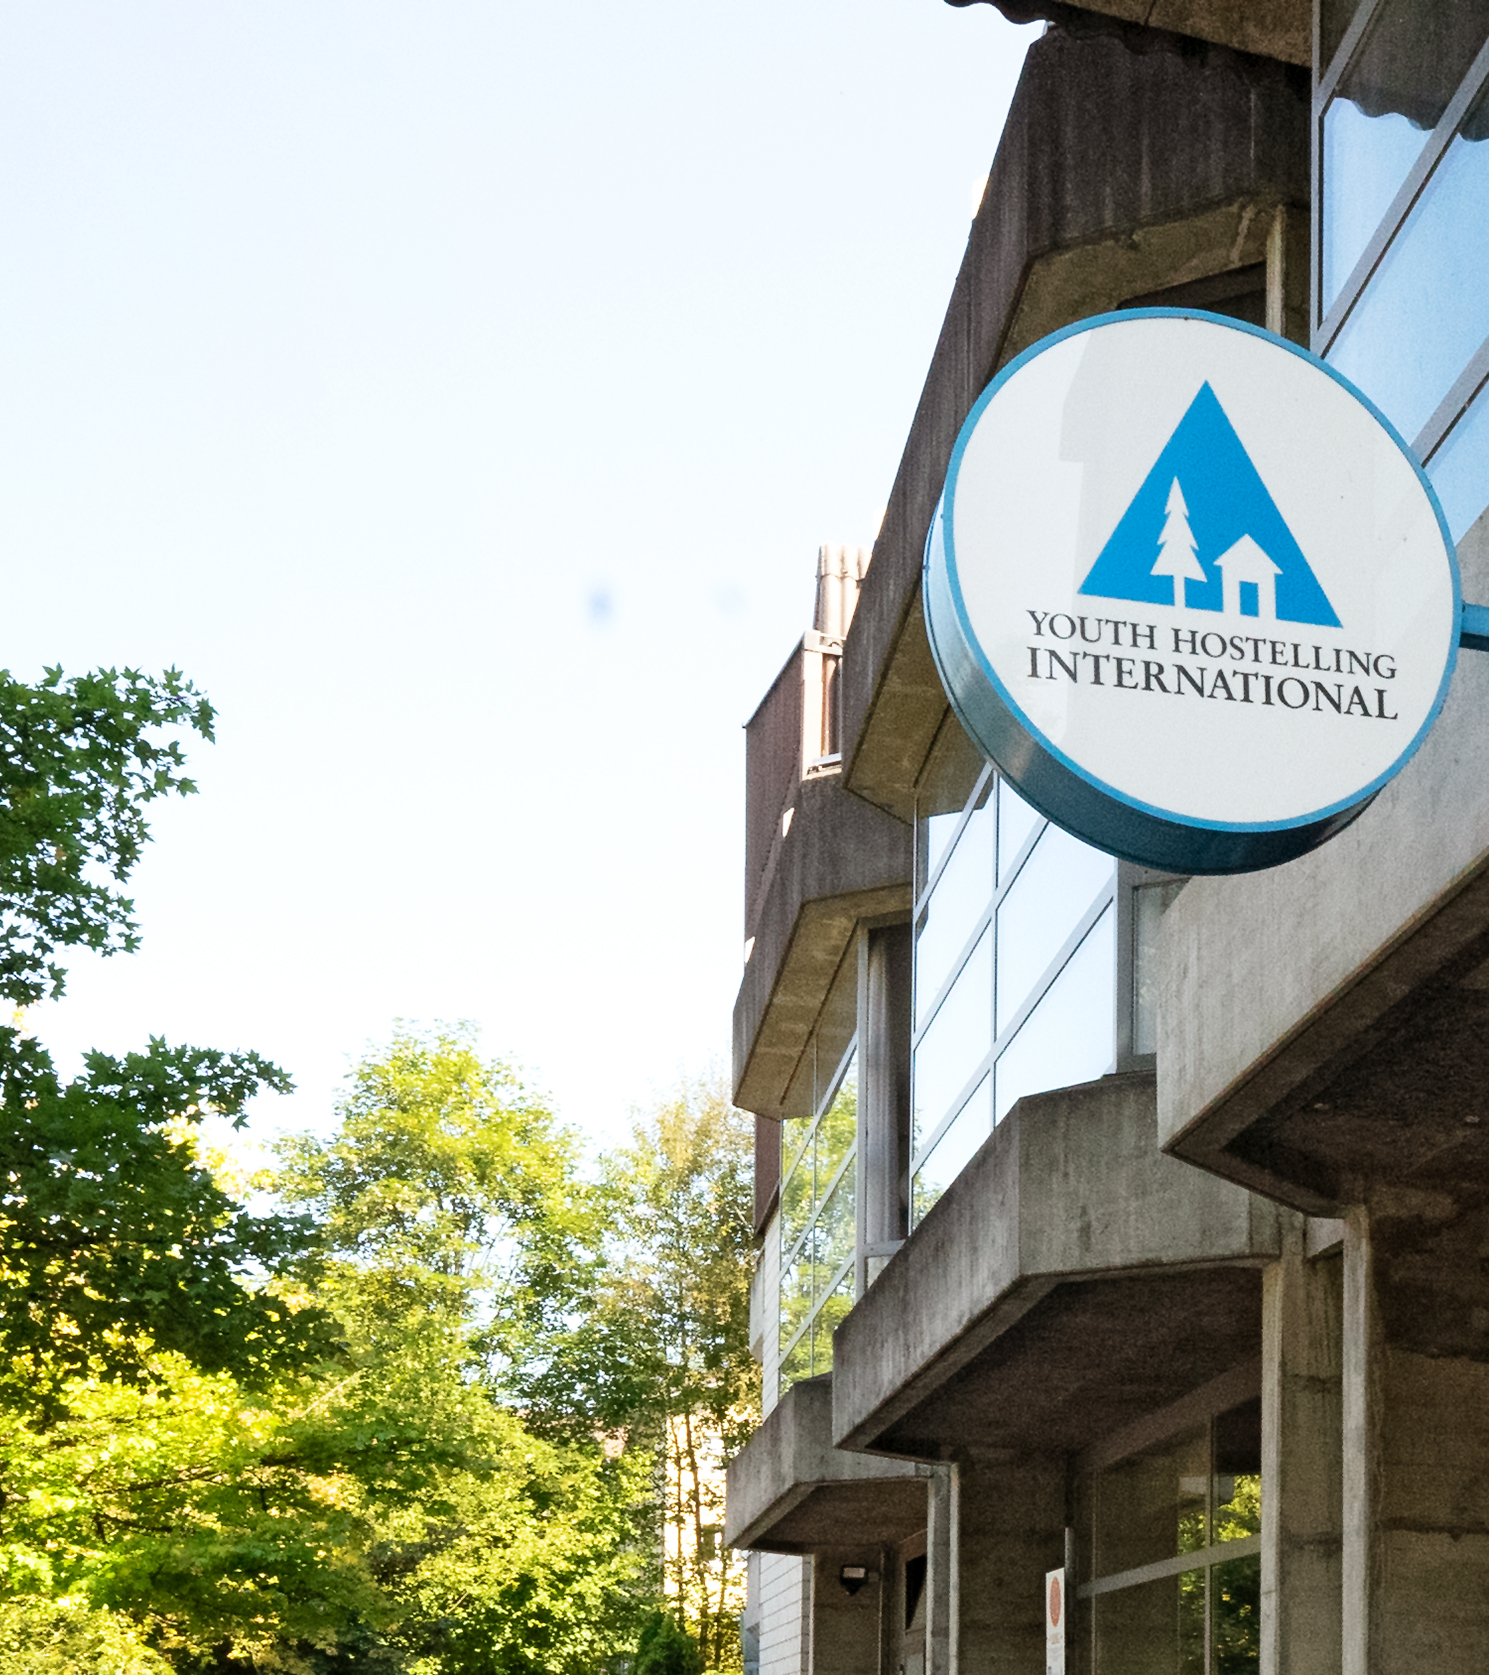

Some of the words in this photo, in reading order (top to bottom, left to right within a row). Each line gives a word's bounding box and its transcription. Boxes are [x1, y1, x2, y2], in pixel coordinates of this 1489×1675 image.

[1026, 609, 1158, 650] YOUTH
[1171, 627, 1398, 680] HOSTELLING
[1026, 646, 1399, 720] INTERNATIONAL
